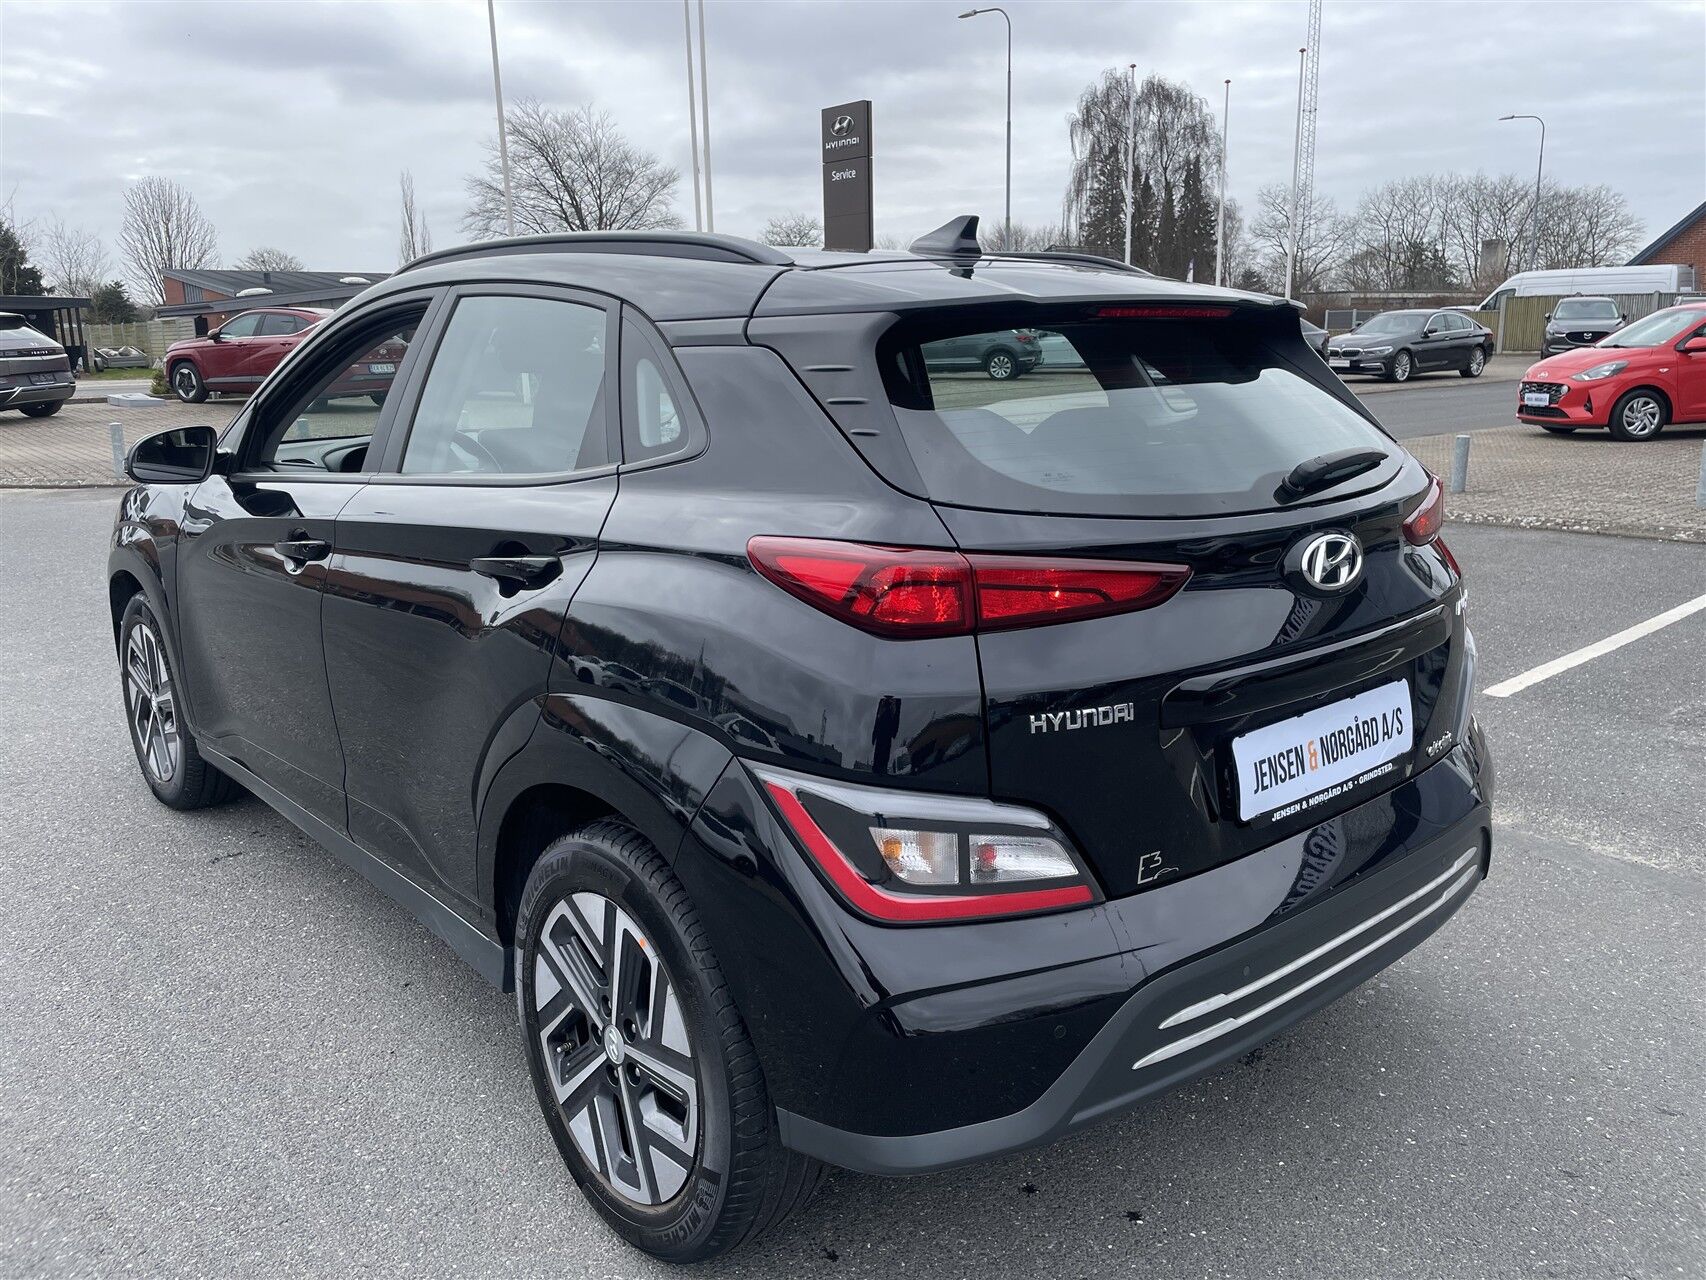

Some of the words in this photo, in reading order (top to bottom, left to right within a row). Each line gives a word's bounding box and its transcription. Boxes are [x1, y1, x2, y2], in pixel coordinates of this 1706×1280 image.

[825, 136, 860, 150] HYUNDAI
[831, 168, 857, 182] Service
[1029, 702, 1135, 734] HYUNDAI
[1253, 744, 1306, 795] JENSEN
[1307, 739, 1319, 772] &
[1319, 715, 1379, 767] NØRGÅRD
[1382, 706, 1404, 743] A/S
[1271, 802, 1301, 822] JENSEN
[1301, 800, 1308, 810] &
[1342, 781, 1354, 793] A/S
[1358, 762, 1394, 785] GRINDSTED
